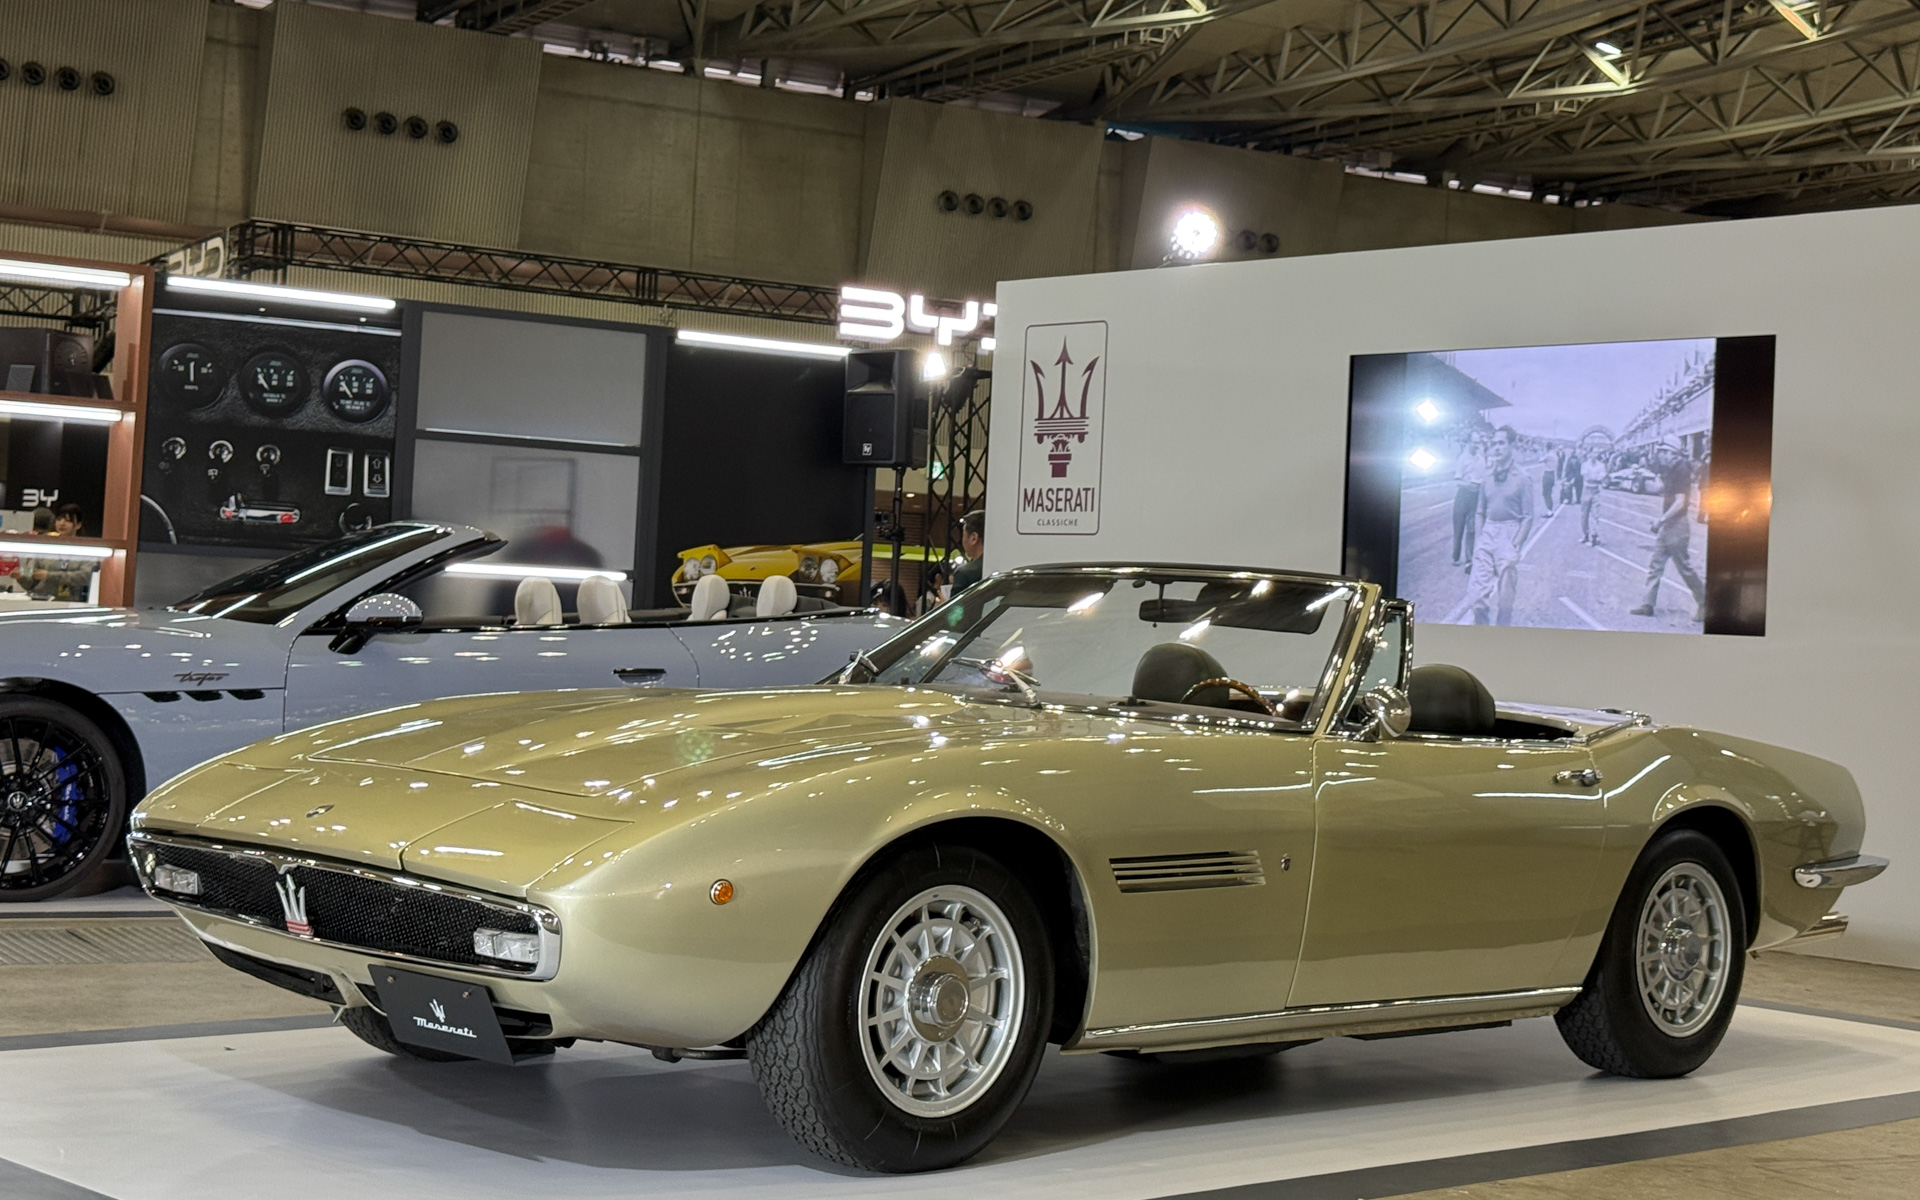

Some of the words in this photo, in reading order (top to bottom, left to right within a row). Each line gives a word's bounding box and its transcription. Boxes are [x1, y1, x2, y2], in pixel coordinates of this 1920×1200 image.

[1023, 487, 1095, 513] MASERATI
[1036, 518, 1079, 527] CLASSICHE
[412, 1016, 478, 1038] Maserati
